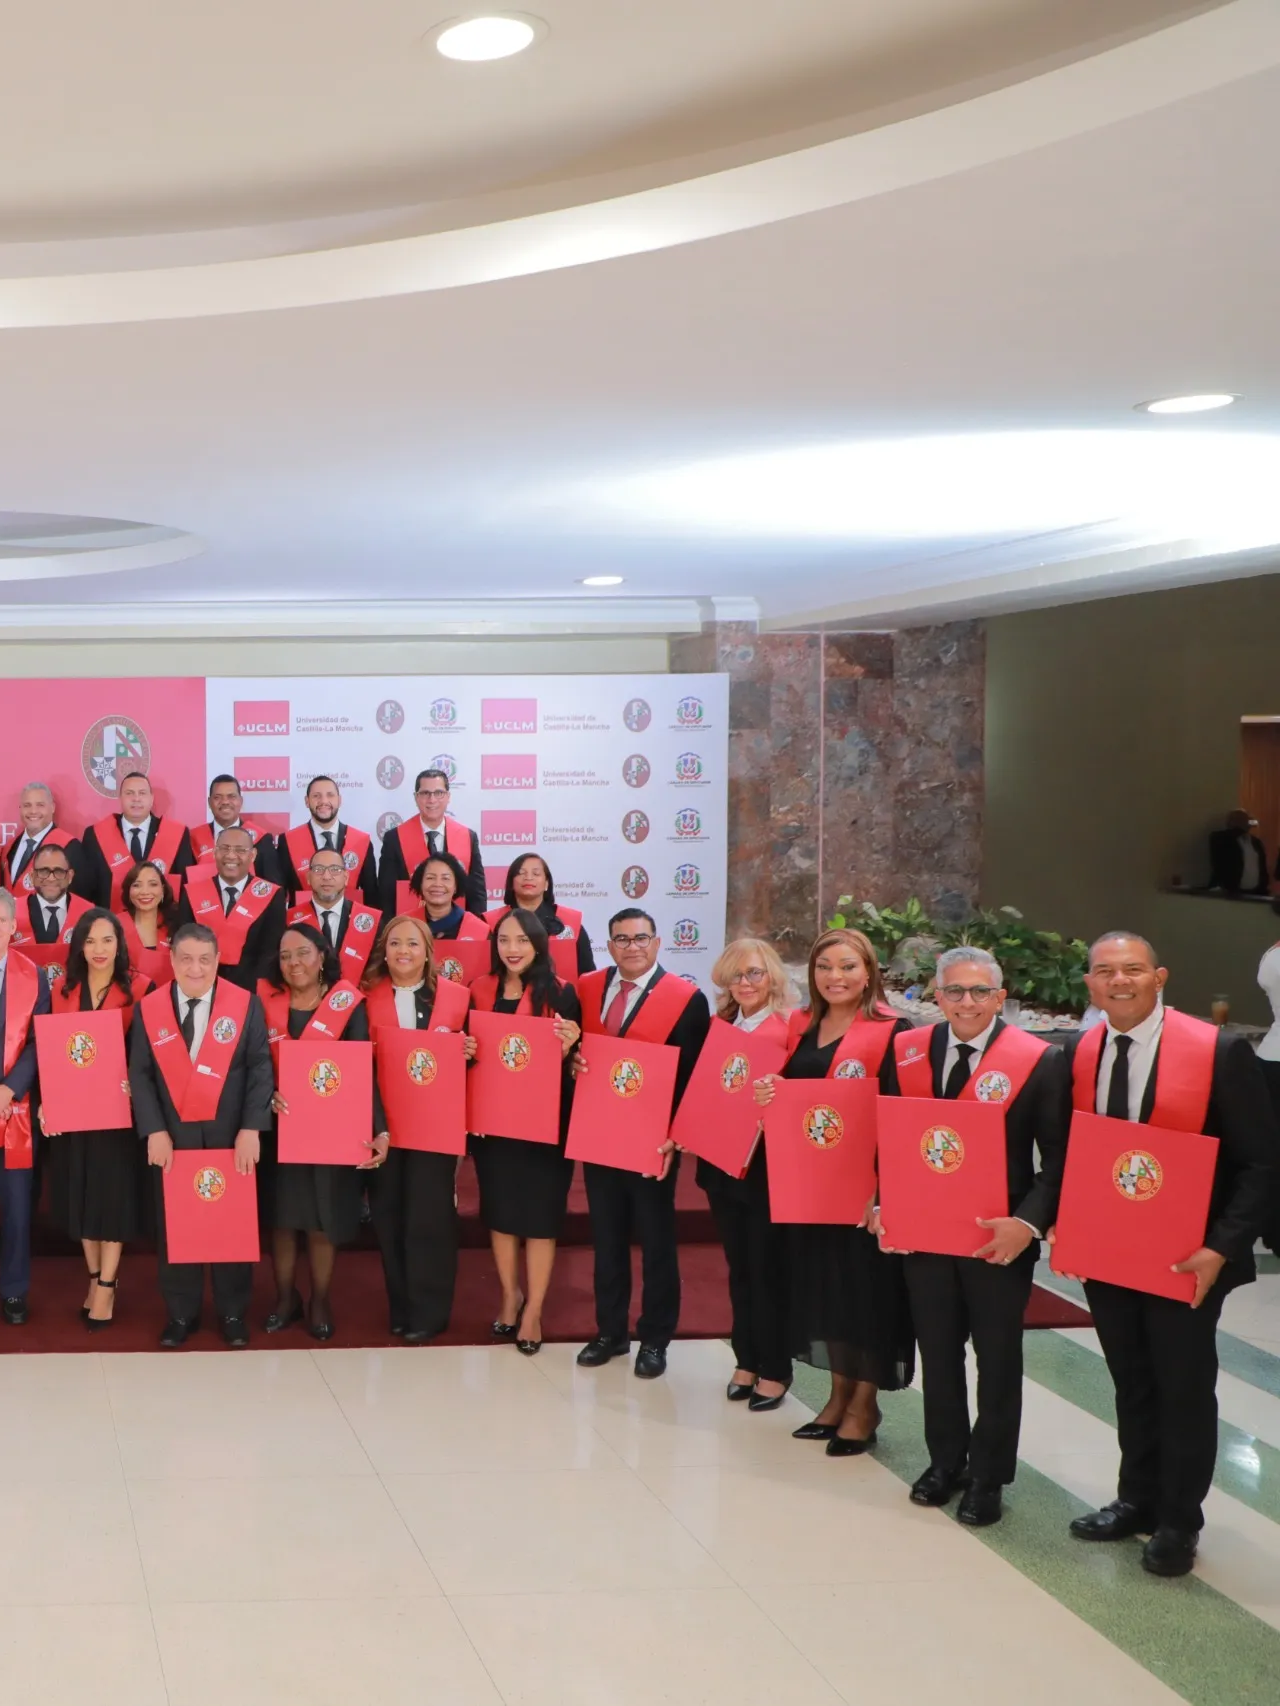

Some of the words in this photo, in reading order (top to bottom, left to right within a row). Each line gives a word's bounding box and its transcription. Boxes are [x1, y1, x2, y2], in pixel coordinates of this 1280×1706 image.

[246, 723, 287, 733] UCLM
[493, 721, 534, 731] UCLM
[246, 779, 287, 789] UCLM
[493, 777, 534, 787] UCLM
[493, 832, 533, 842] UCLM
